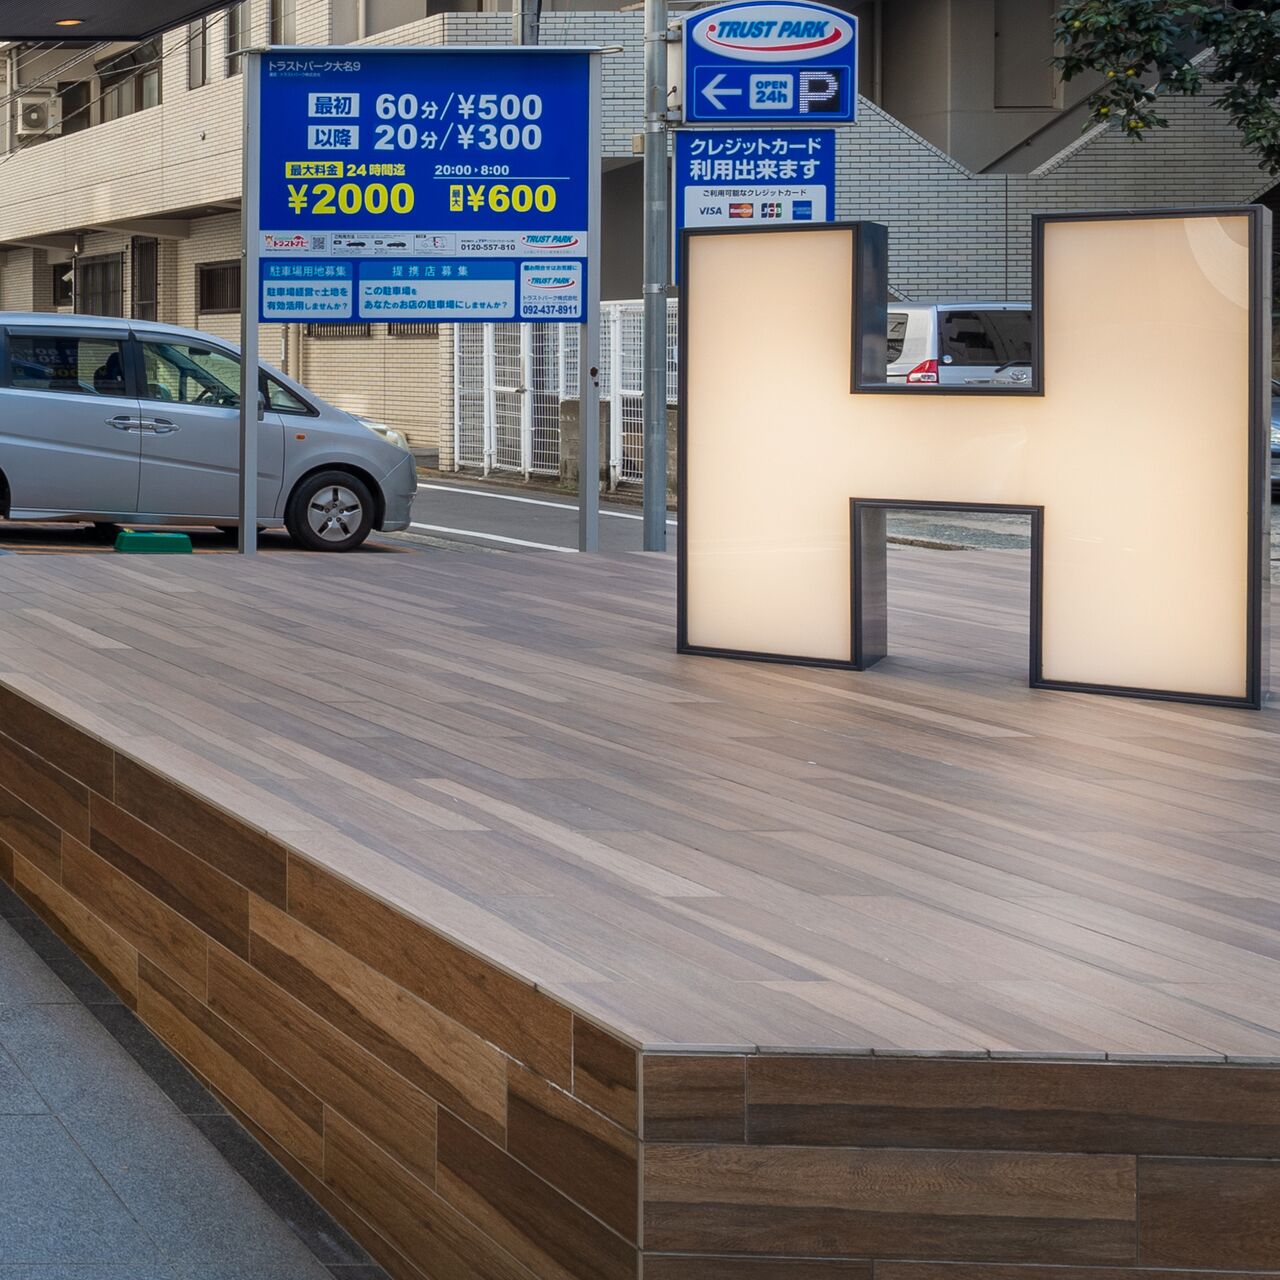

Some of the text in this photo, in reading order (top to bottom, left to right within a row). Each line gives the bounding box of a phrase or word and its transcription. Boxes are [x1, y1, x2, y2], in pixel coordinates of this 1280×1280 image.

[717, 21, 829, 39] TRUST PARK
[269, 61, 361, 72] トラストパーク大名9
[756, 81, 787, 89] OPEN
[756, 90, 787, 103] 24h
[800, 72, 837, 113] P
[314, 96, 352, 116] 最初
[314, 128, 352, 148] 以降
[691, 138, 821, 155] クレジットカード
[290, 164, 339, 176] 最大料金
[690, 159, 820, 180] 利用出来ます
[288, 183, 414, 214] ¥2000
[467, 185, 556, 212] ¥600
[704, 189, 806, 197] ご利用可能なクレジットカード
[699, 206, 723, 215] VISA
[526, 235, 574, 243] TRUST PARK
[460, 243, 516, 251] 0120-557-810
[270, 265, 346, 277] 駐車場用地募集
[392, 265, 468, 277] 提携店募集
[267, 287, 349, 297] 駐車場経営で土地を
[364, 286, 417, 296] この駐車場を
[523, 305, 578, 315] 092-437-8911
